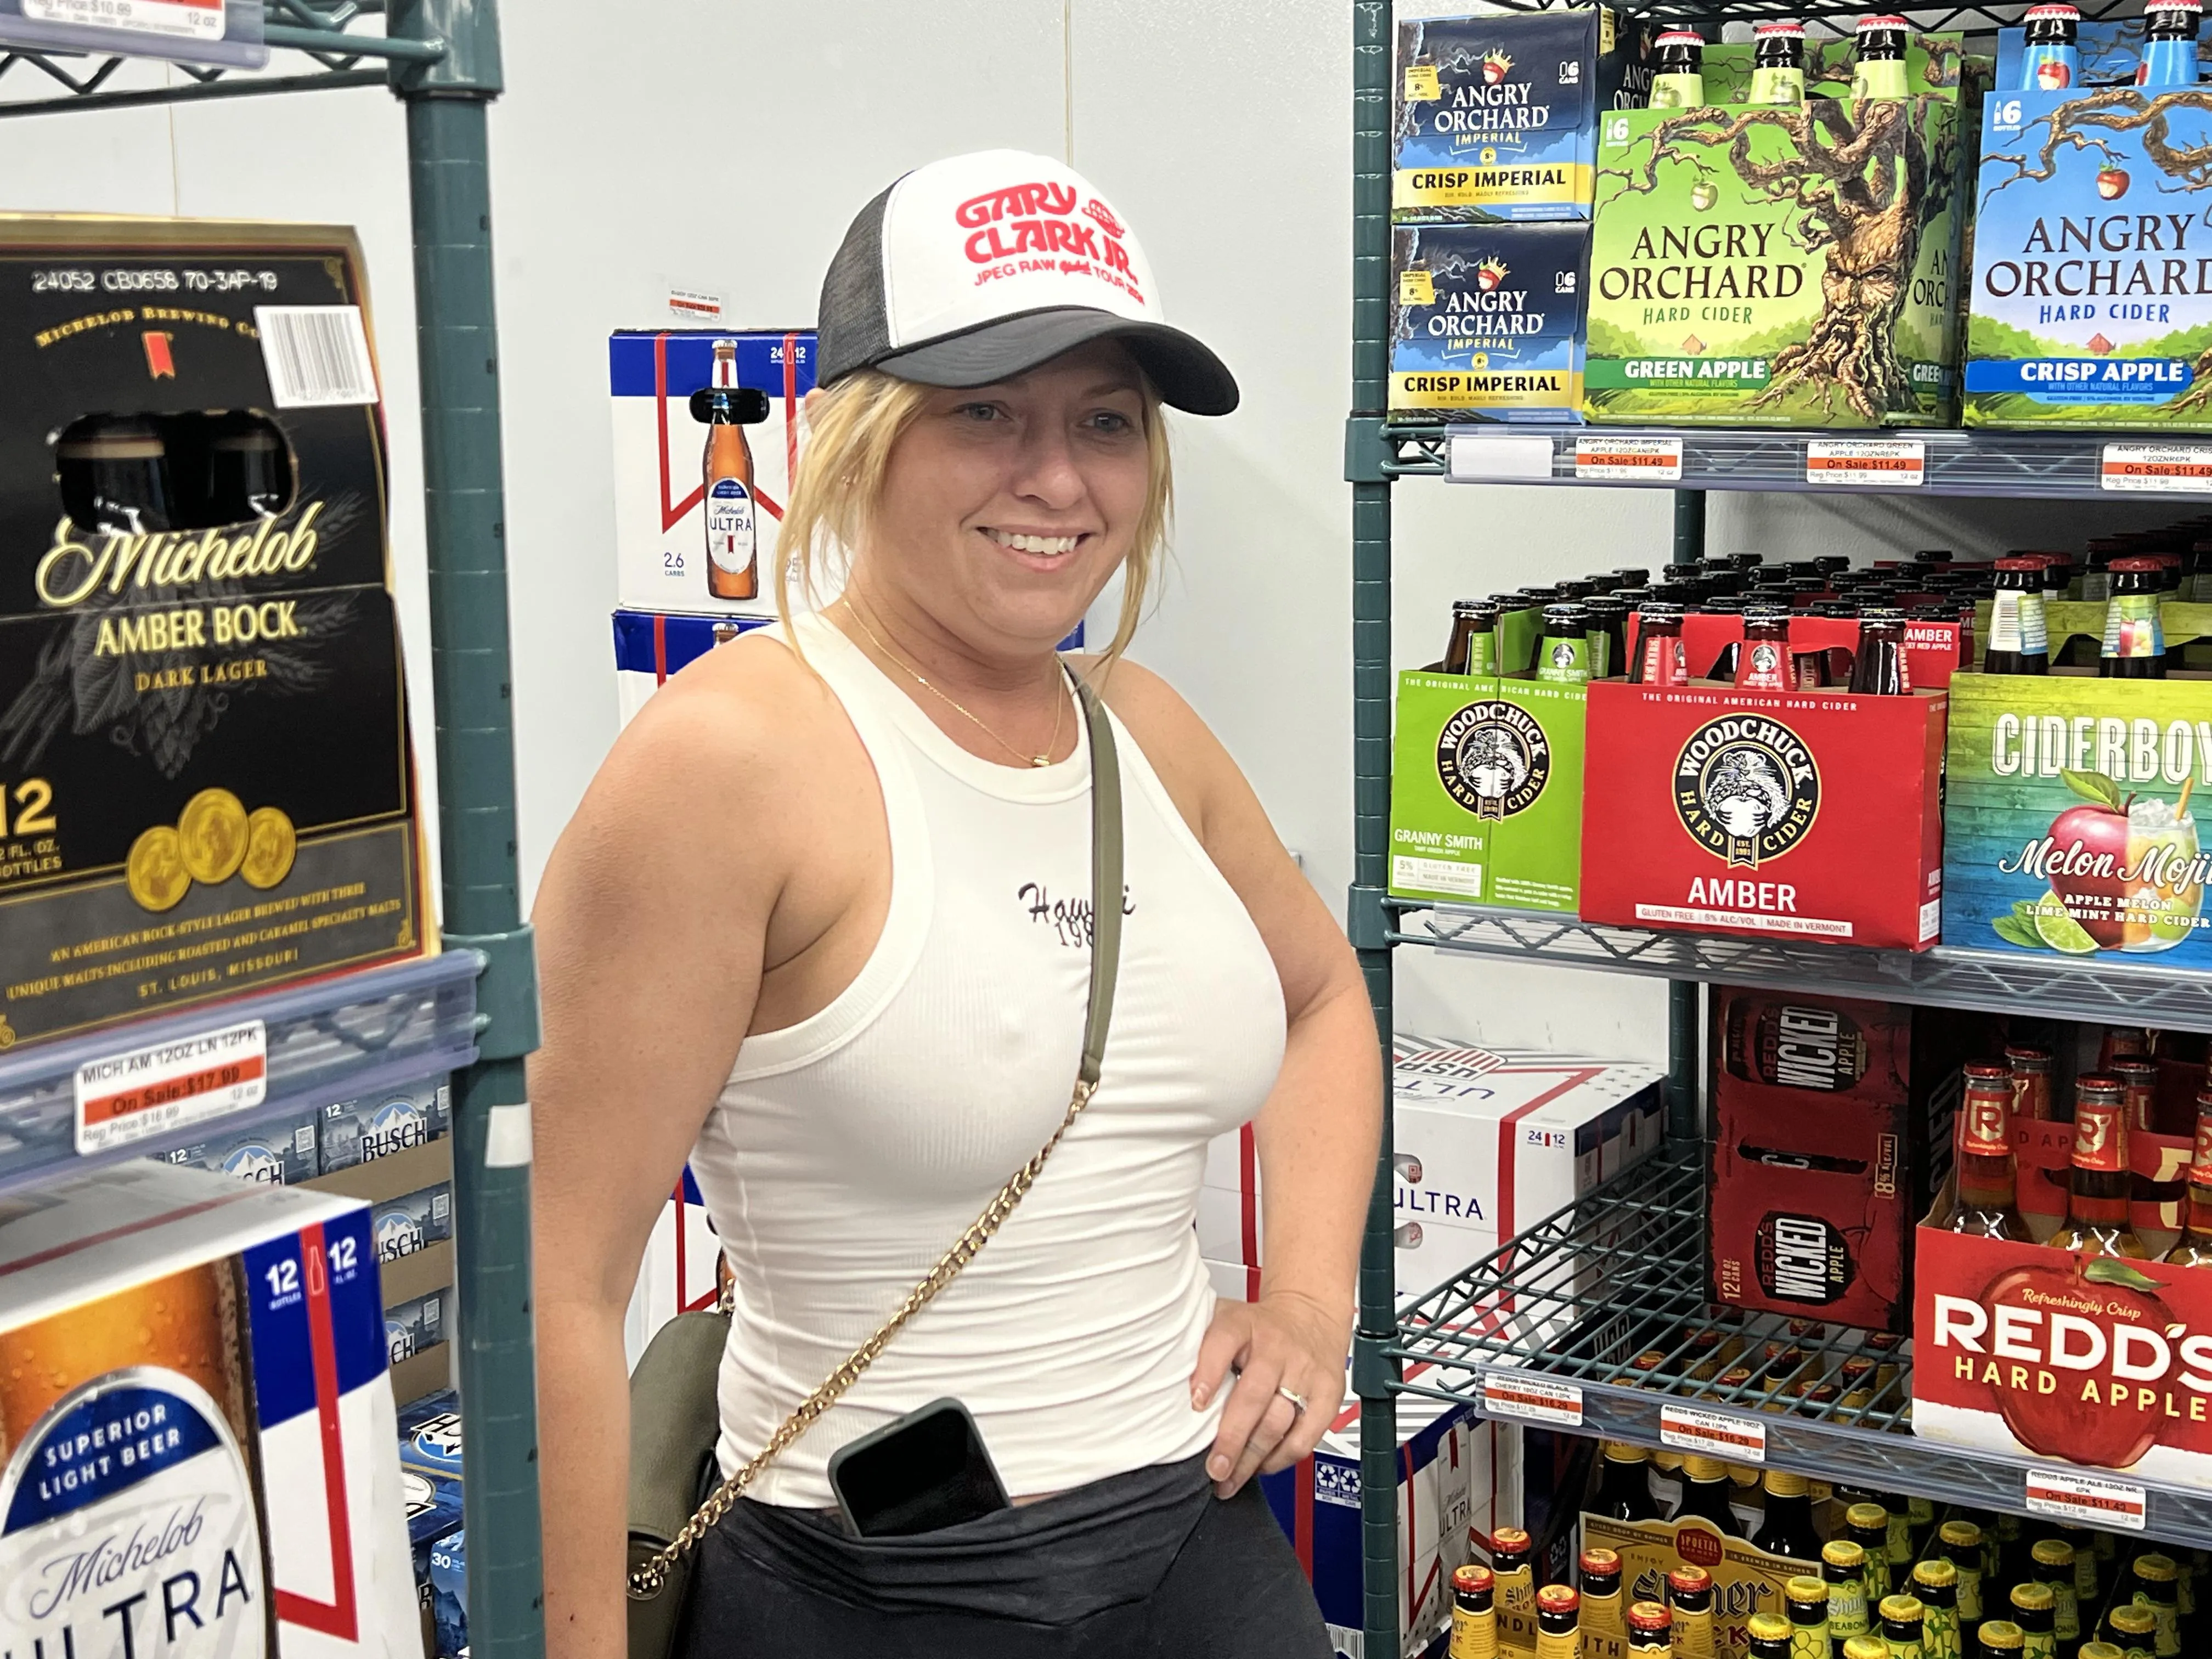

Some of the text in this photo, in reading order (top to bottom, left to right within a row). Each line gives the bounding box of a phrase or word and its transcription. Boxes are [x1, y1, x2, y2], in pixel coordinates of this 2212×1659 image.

[187, 12, 200, 25] 12
[203, 16, 217, 27] oz
[1452, 82, 1532, 109] ANGRY
[1434, 106, 1548, 132] ORCHARD
[2002, 100, 2022, 124] 6
[1455, 131, 1522, 146] IMPERIAL
[1613, 117, 1629, 140] 6
[1412, 169, 1566, 189] CRISP IMPERIAL
[955, 182, 1077, 228] GARY
[964, 219, 1100, 263] CLARK
[1631, 223, 1775, 261] ANGRY
[2023, 214, 2196, 253] ANGRY
[33, 272, 95, 291] 24052
[974, 264, 1016, 286] JPEG
[1019, 259, 1056, 274] RAW
[1092, 266, 1126, 290] TOUR
[1600, 264, 1803, 301] ORCHARD
[1445, 291, 1528, 313] ANGRY
[1643, 307, 1752, 325] HARD CIDER
[2040, 303, 2170, 324] HARD CIDER
[35, 305, 230, 349] MICHELOB BREWING
[1428, 314, 1543, 336] ORCHARD
[770, 346, 783, 359] 24
[795, 347, 806, 359] 12
[1448, 337, 1514, 351] IMPERIAL
[1624, 360, 1766, 379] GREEN APPLE
[2020, 362, 2184, 382] CRISP APPLE
[1404, 375, 1561, 392] CRISP IMPERIAL
[2048, 382, 2153, 392] WITH OTHER NATURAL FLAVORS
[2117, 444, 2191, 454] ANGRY ORCHARD
[1590, 456, 1605, 465] On
[1827, 459, 1842, 469] On
[2124, 465, 2142, 475] On
[713, 505, 745, 516] Michelob
[709, 517, 753, 531] ULTRA
[35, 501, 324, 607] Michelob
[664, 551, 685, 568] 2.6
[95, 601, 299, 657] AMBER BOCK
[1904, 628, 1953, 642] AMBER
[135, 659, 268, 692] DARK LAGER
[1748, 672, 1778, 682] AMBER
[1406, 677, 1423, 688] THE
[1426, 679, 1470, 692] ORIGINAL
[1534, 689, 1560, 699] HARD
[1643, 692, 1858, 712] THE ORIGINAL AMERICAN HARD CIDER
[1441, 703, 1547, 760] WOODCHUCK
[1679, 718, 1814, 785] WOODCHUCK
[1992, 713, 2212, 786] CIDERBOY
[1441, 759, 1545, 811] HARD CIDER
[1680, 789, 1813, 853] HARD CIDER
[1394, 828, 1483, 850] GRANNY SMITH
[0, 856, 63, 878] OTTLES
[1400, 860, 1414, 870] 5%
[1999, 837, 2212, 895] Melon Moji
[1018, 882, 1136, 924] Hawi
[1687, 876, 1798, 913] AMBER
[2064, 894, 2173, 912] APPLE MELON
[51, 945, 71, 963] AN
[74, 933, 138, 958] AMERICAN
[217, 907, 252, 926] LAGER
[254, 896, 300, 918] BREWED
[301, 889, 330, 907] WITH
[331, 882, 366, 901] THREE
[1641, 907, 1847, 934] GLUTEN FREE ALC/VOL MADE IN VERMONT
[2025, 904, 2211, 928] LIME MINT HARD CIDER
[6, 898, 402, 1001] UNIQUE MALTS INCLUDING ROASTED AND CARAMEL SPECIALTY MALTS
[139, 980, 164, 997] ST.
[227, 947, 299, 977] MISSOURI
[83, 1028, 258, 1085] MICH AM 12OZ LN 12PK
[1778, 1006, 1838, 1088] WICKED
[1838, 1031, 1855, 1075] APPLE
[112, 1097, 137, 1115] On
[326, 1103, 341, 1118] 12
[1976, 1105, 2002, 1133] R
[360, 1117, 428, 1164] BUSCH
[1527, 1130, 1542, 1142] 24
[1552, 1133, 1566, 1146] 12
[170, 1148, 188, 1164] 12
[328, 1236, 358, 1272] 12
[1775, 1217, 1827, 1299] WICKED
[1829, 1245, 1844, 1284] APPLE
[264, 1259, 300, 1296] 12
[1731, 1261, 1741, 1283] CANS
[1723, 1281, 1741, 1299] 12
[2022, 1288, 2142, 1321] Refreshingly Crisp
[1933, 1293, 2212, 1394] REDD'S
[1495, 1381, 1554, 1397] CHERRY CAN
[1502, 1391, 1515, 1401] On
[1955, 1355, 2207, 1423] HARD APPLE
[1664, 1406, 1741, 1425] REDDS WICKED APPLE
[1695, 1419, 1710, 1427] CAN
[44, 1403, 168, 1468] SUPERIOR
[1678, 1424, 1692, 1434] On
[38, 1427, 182, 1502] LIGHT BEER
[2059, 1475, 2085, 1485] APPLE
[2045, 1491, 2062, 1502] On
[1438, 1497, 1472, 1538] ULTRA
[1680, 1533, 1719, 1554] SPOETZL
[30, 1496, 206, 1621] Michelob
[431, 1551, 452, 1570] 30
[1630, 1553, 1664, 1566] ENJOY
